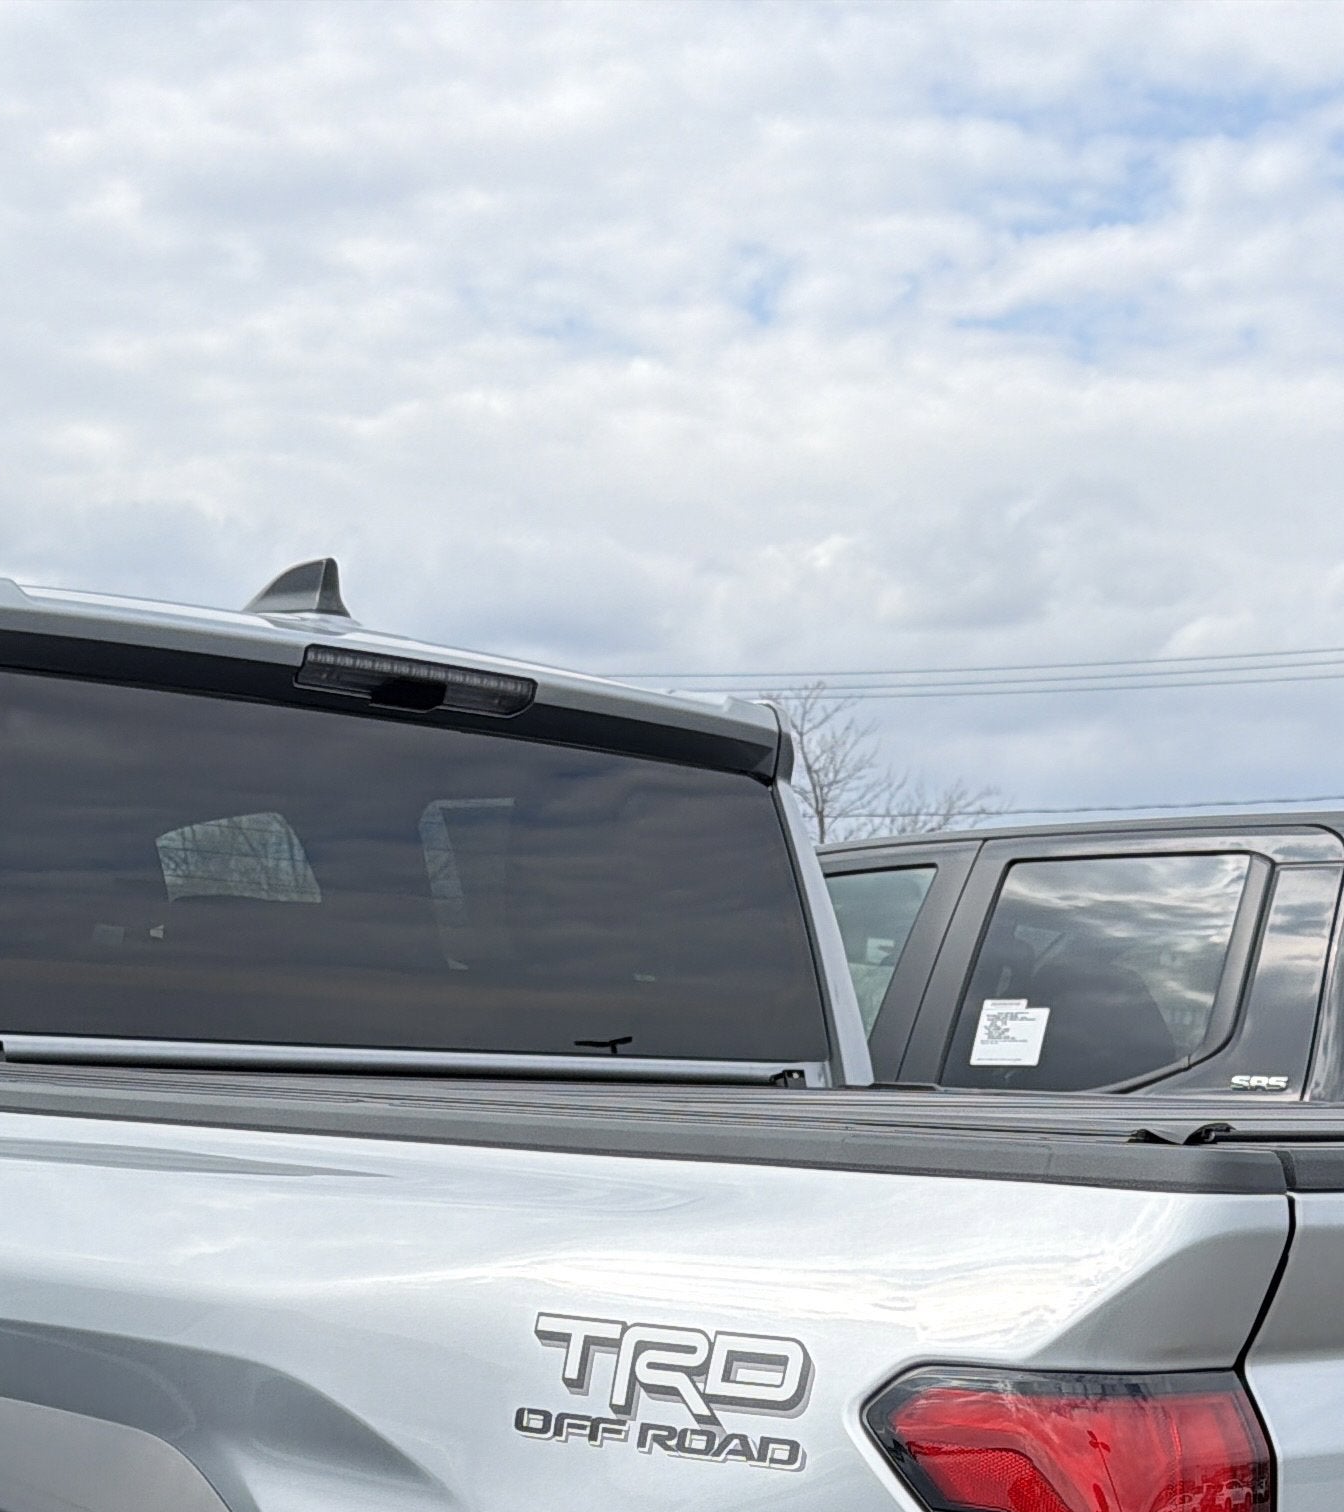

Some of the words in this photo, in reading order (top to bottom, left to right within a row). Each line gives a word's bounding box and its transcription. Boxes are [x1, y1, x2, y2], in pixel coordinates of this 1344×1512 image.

[534, 1311, 816, 1433] TRD
[514, 1407, 630, 1447] OFF
[637, 1422, 807, 1473] ROAD
